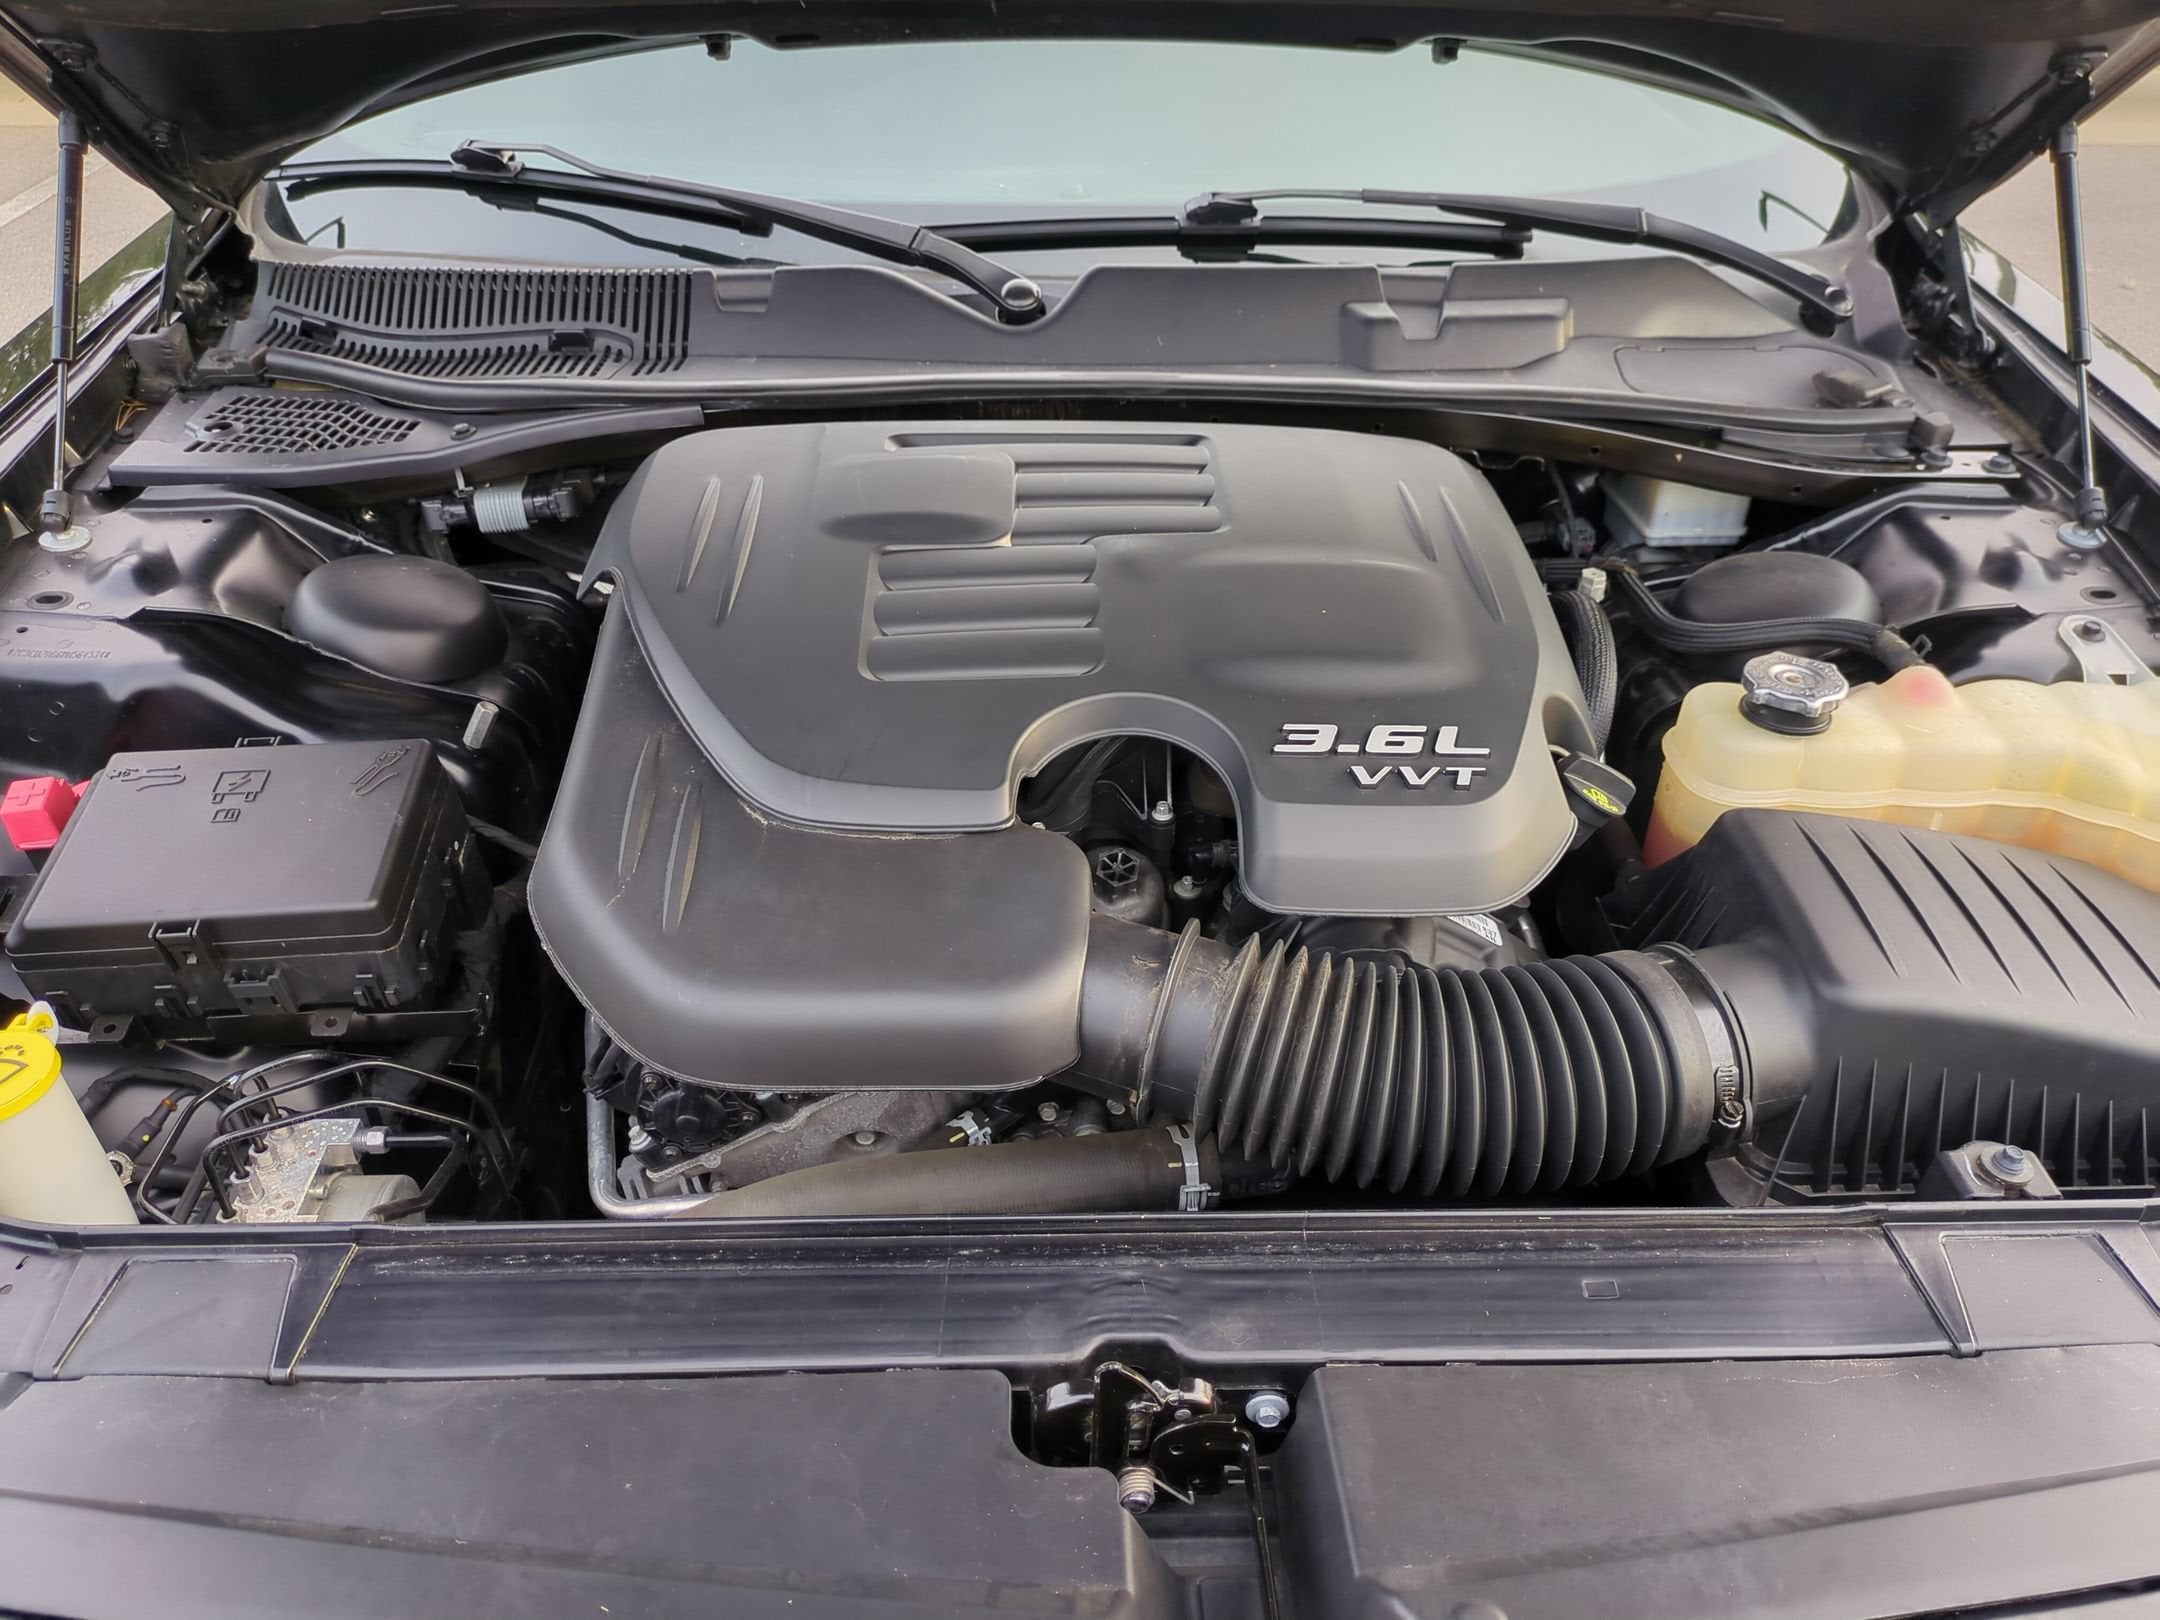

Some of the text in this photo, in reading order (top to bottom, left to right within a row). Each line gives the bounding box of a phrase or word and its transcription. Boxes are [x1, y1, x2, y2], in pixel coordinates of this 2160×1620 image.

[63, 219, 72, 275] STABILUS
[1272, 723, 1490, 757] 3.6L
[1348, 765, 1487, 788] VVT
